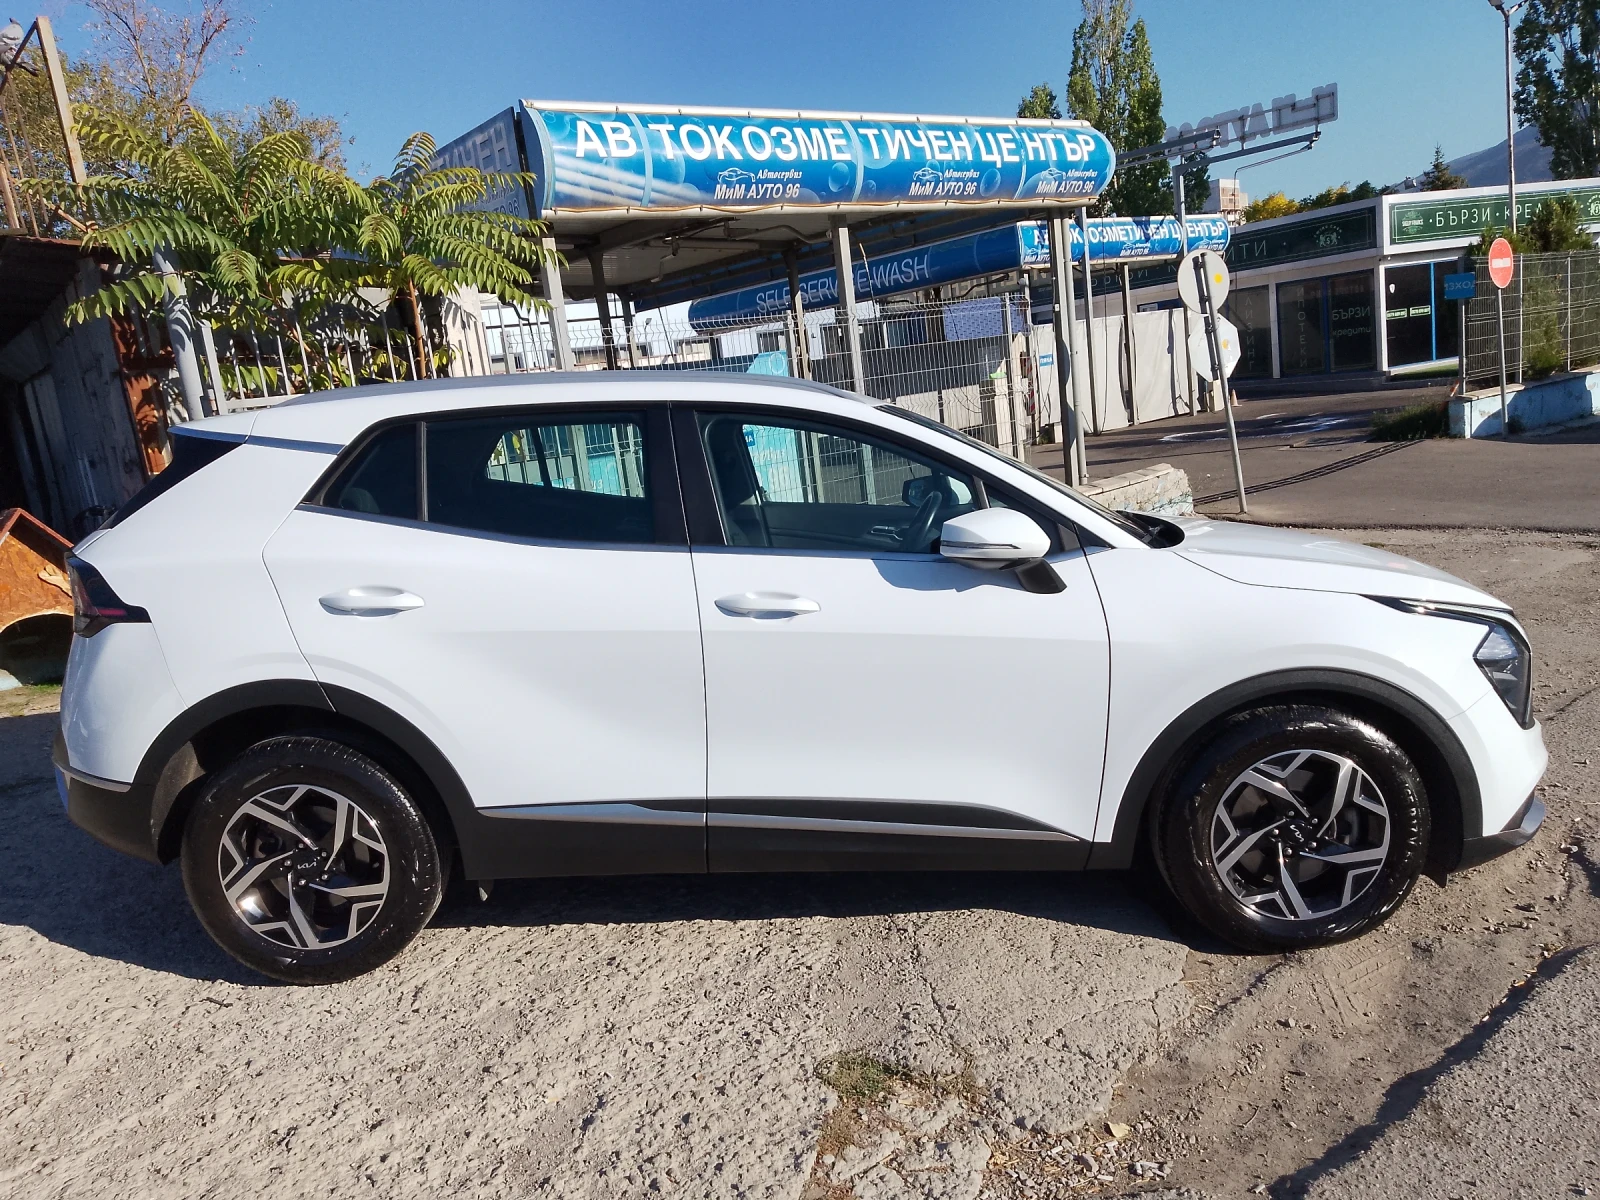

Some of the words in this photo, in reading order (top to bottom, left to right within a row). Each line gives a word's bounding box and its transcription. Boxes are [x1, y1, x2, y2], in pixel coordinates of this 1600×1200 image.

[757, 168, 803, 181] Автосервиз
[714, 183, 746, 200] МиМ
[747, 183, 783, 199] АУТО
[785, 183, 801, 198] 96
[908, 181, 935, 196] МиМ
[935, 181, 964, 196] АУТО
[964, 181, 977, 195] 96
[1035, 181, 1059, 194] МиМ
[1058, 180, 1083, 193] АУТО
[1082, 181, 1094, 193] 96
[1435, 206, 1491, 227] БЪРЗИ
[1332, 305, 1371, 321] БЪРЗИ
